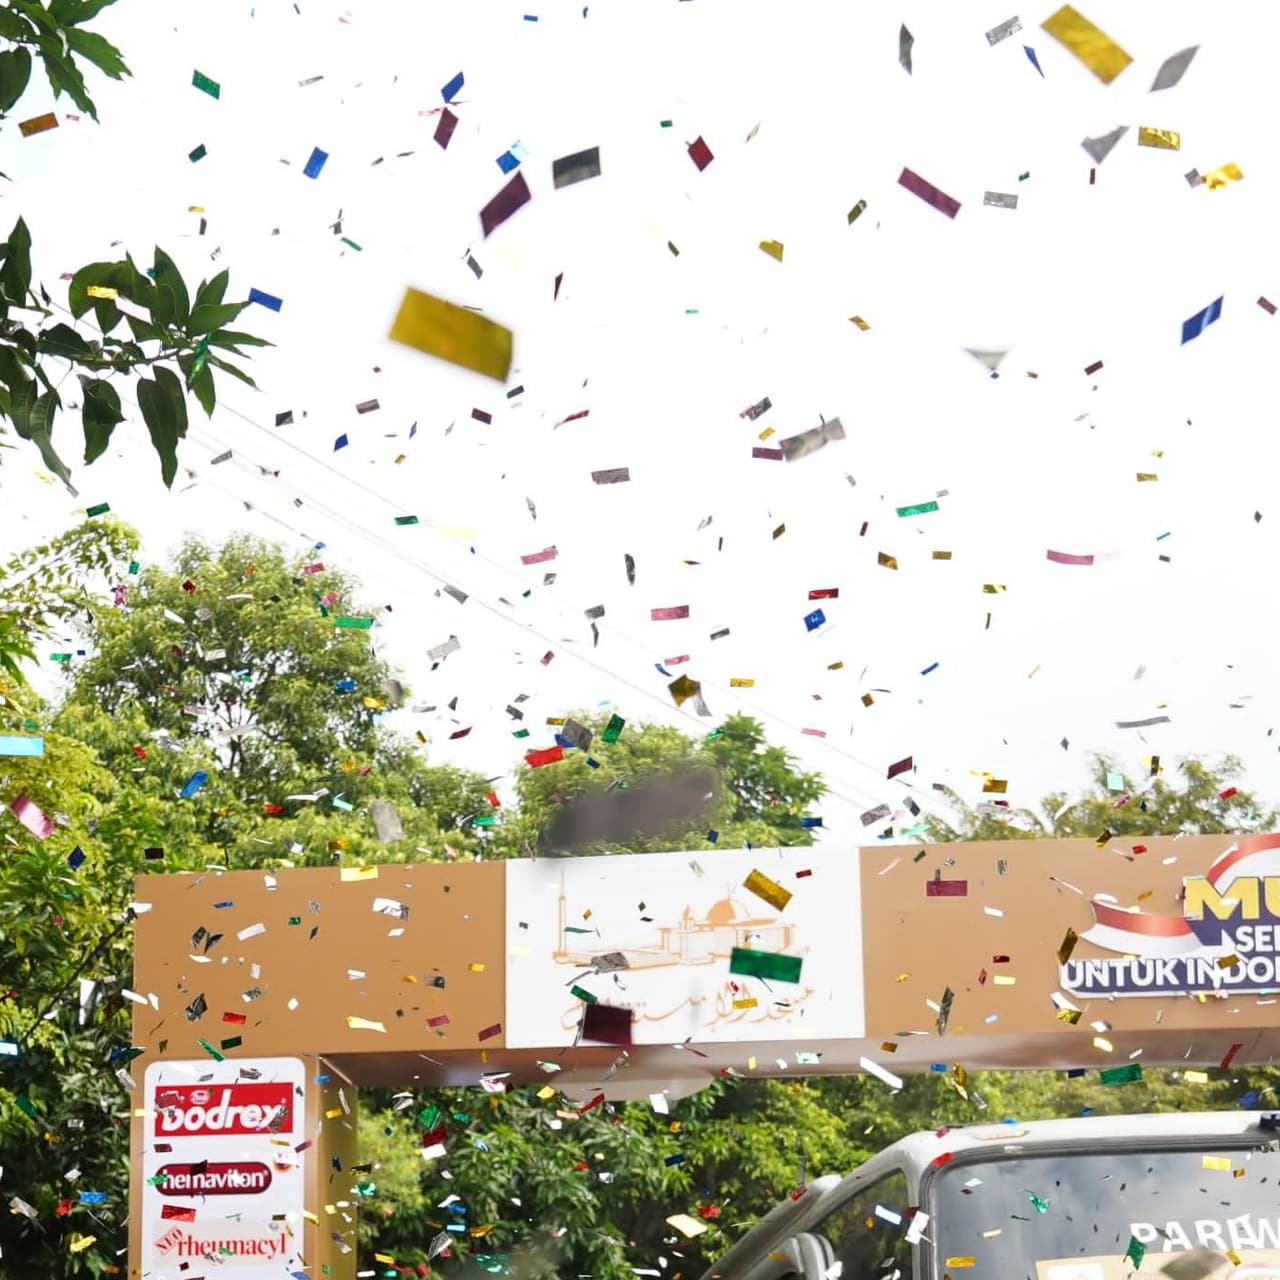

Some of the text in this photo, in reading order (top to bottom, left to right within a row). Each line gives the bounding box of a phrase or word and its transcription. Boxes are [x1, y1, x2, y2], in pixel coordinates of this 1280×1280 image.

[1066, 958, 1178, 989] UNTUK
[155, 1227, 184, 1251] NEO
[177, 1233, 287, 1259] rheumacyl
